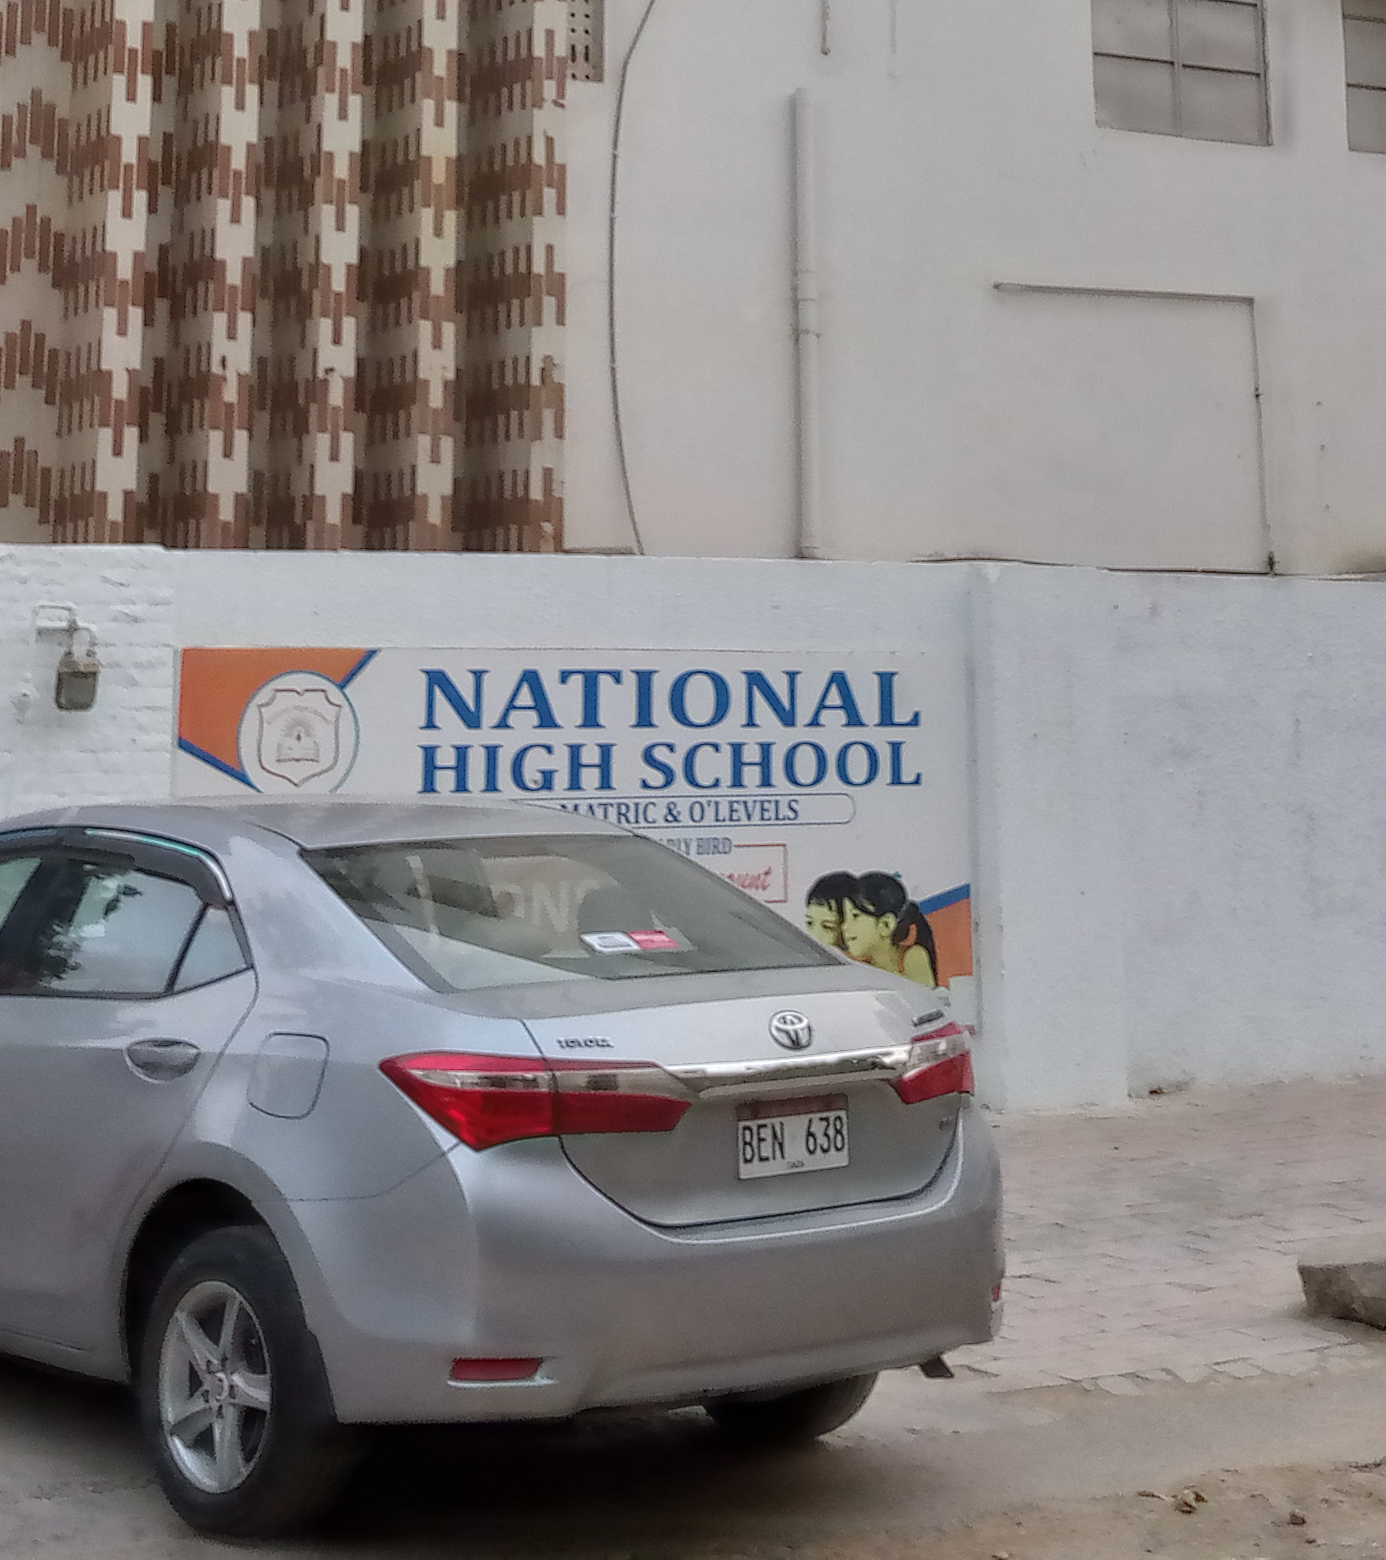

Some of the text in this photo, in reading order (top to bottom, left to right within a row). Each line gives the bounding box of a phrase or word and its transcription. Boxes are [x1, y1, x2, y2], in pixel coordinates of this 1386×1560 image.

[418, 667, 923, 731] NATIONAL
[416, 740, 923, 795] HIGH SCHOOL
[663, 801, 683, 824] &
[689, 798, 800, 824] O'LEVELS
[741, 1115, 846, 1164] BEN 638
